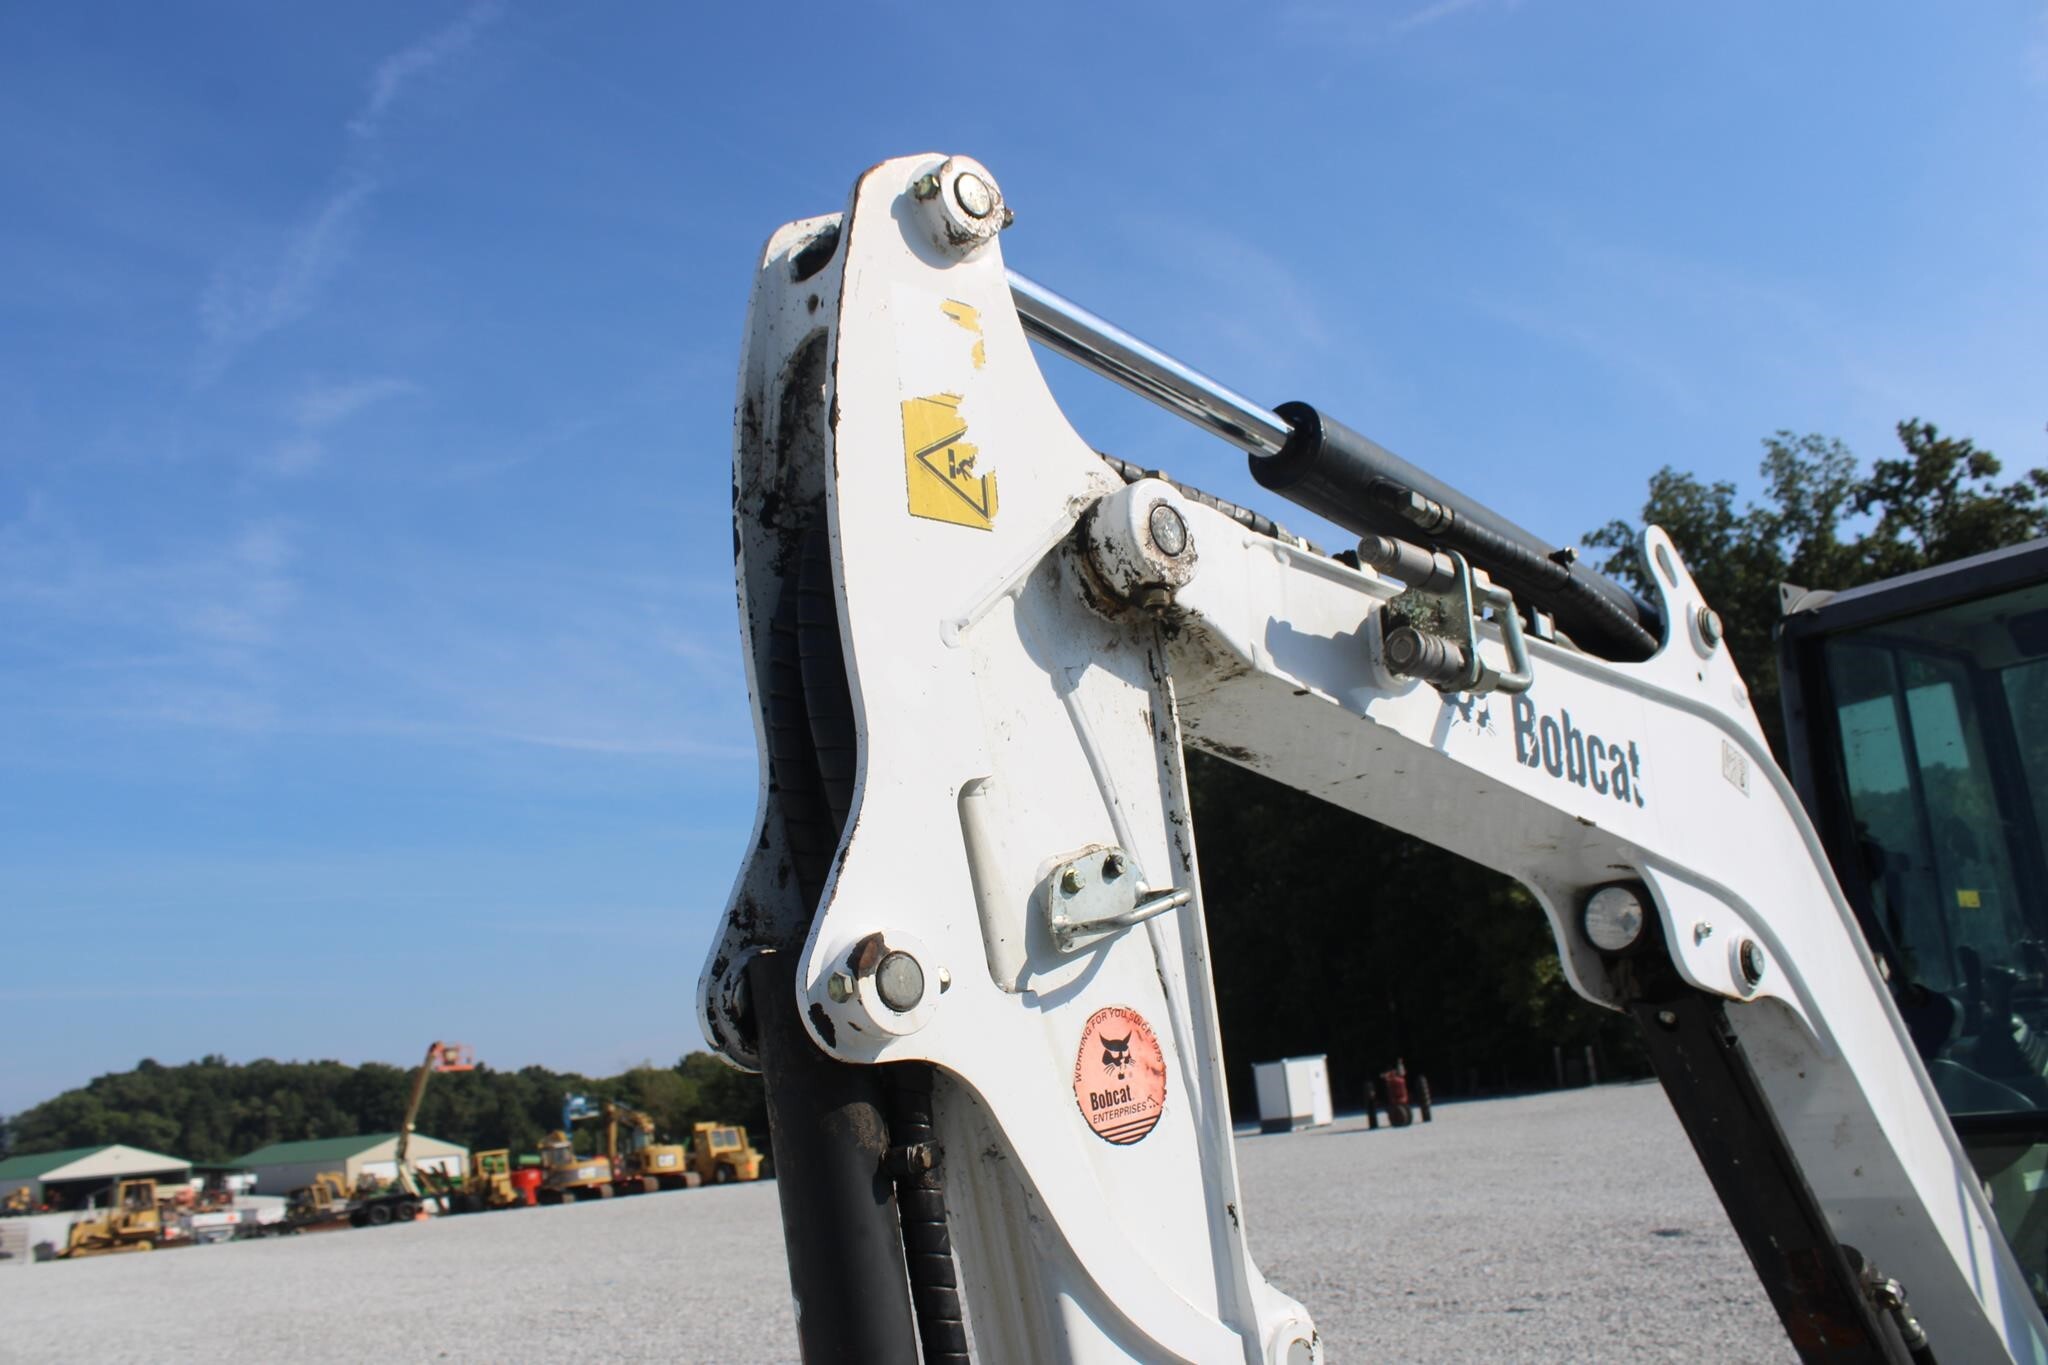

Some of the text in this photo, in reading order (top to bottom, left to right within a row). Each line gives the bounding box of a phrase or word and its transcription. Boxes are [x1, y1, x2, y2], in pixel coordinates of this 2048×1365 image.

[1511, 691, 1645, 808] Bobcat
[1090, 1011, 1107, 1029] FOR
[1109, 1008, 1127, 1018] YOU
[1089, 1084, 1132, 1111] Bobcat
[1093, 1101, 1147, 1124] ENTERPRISES
